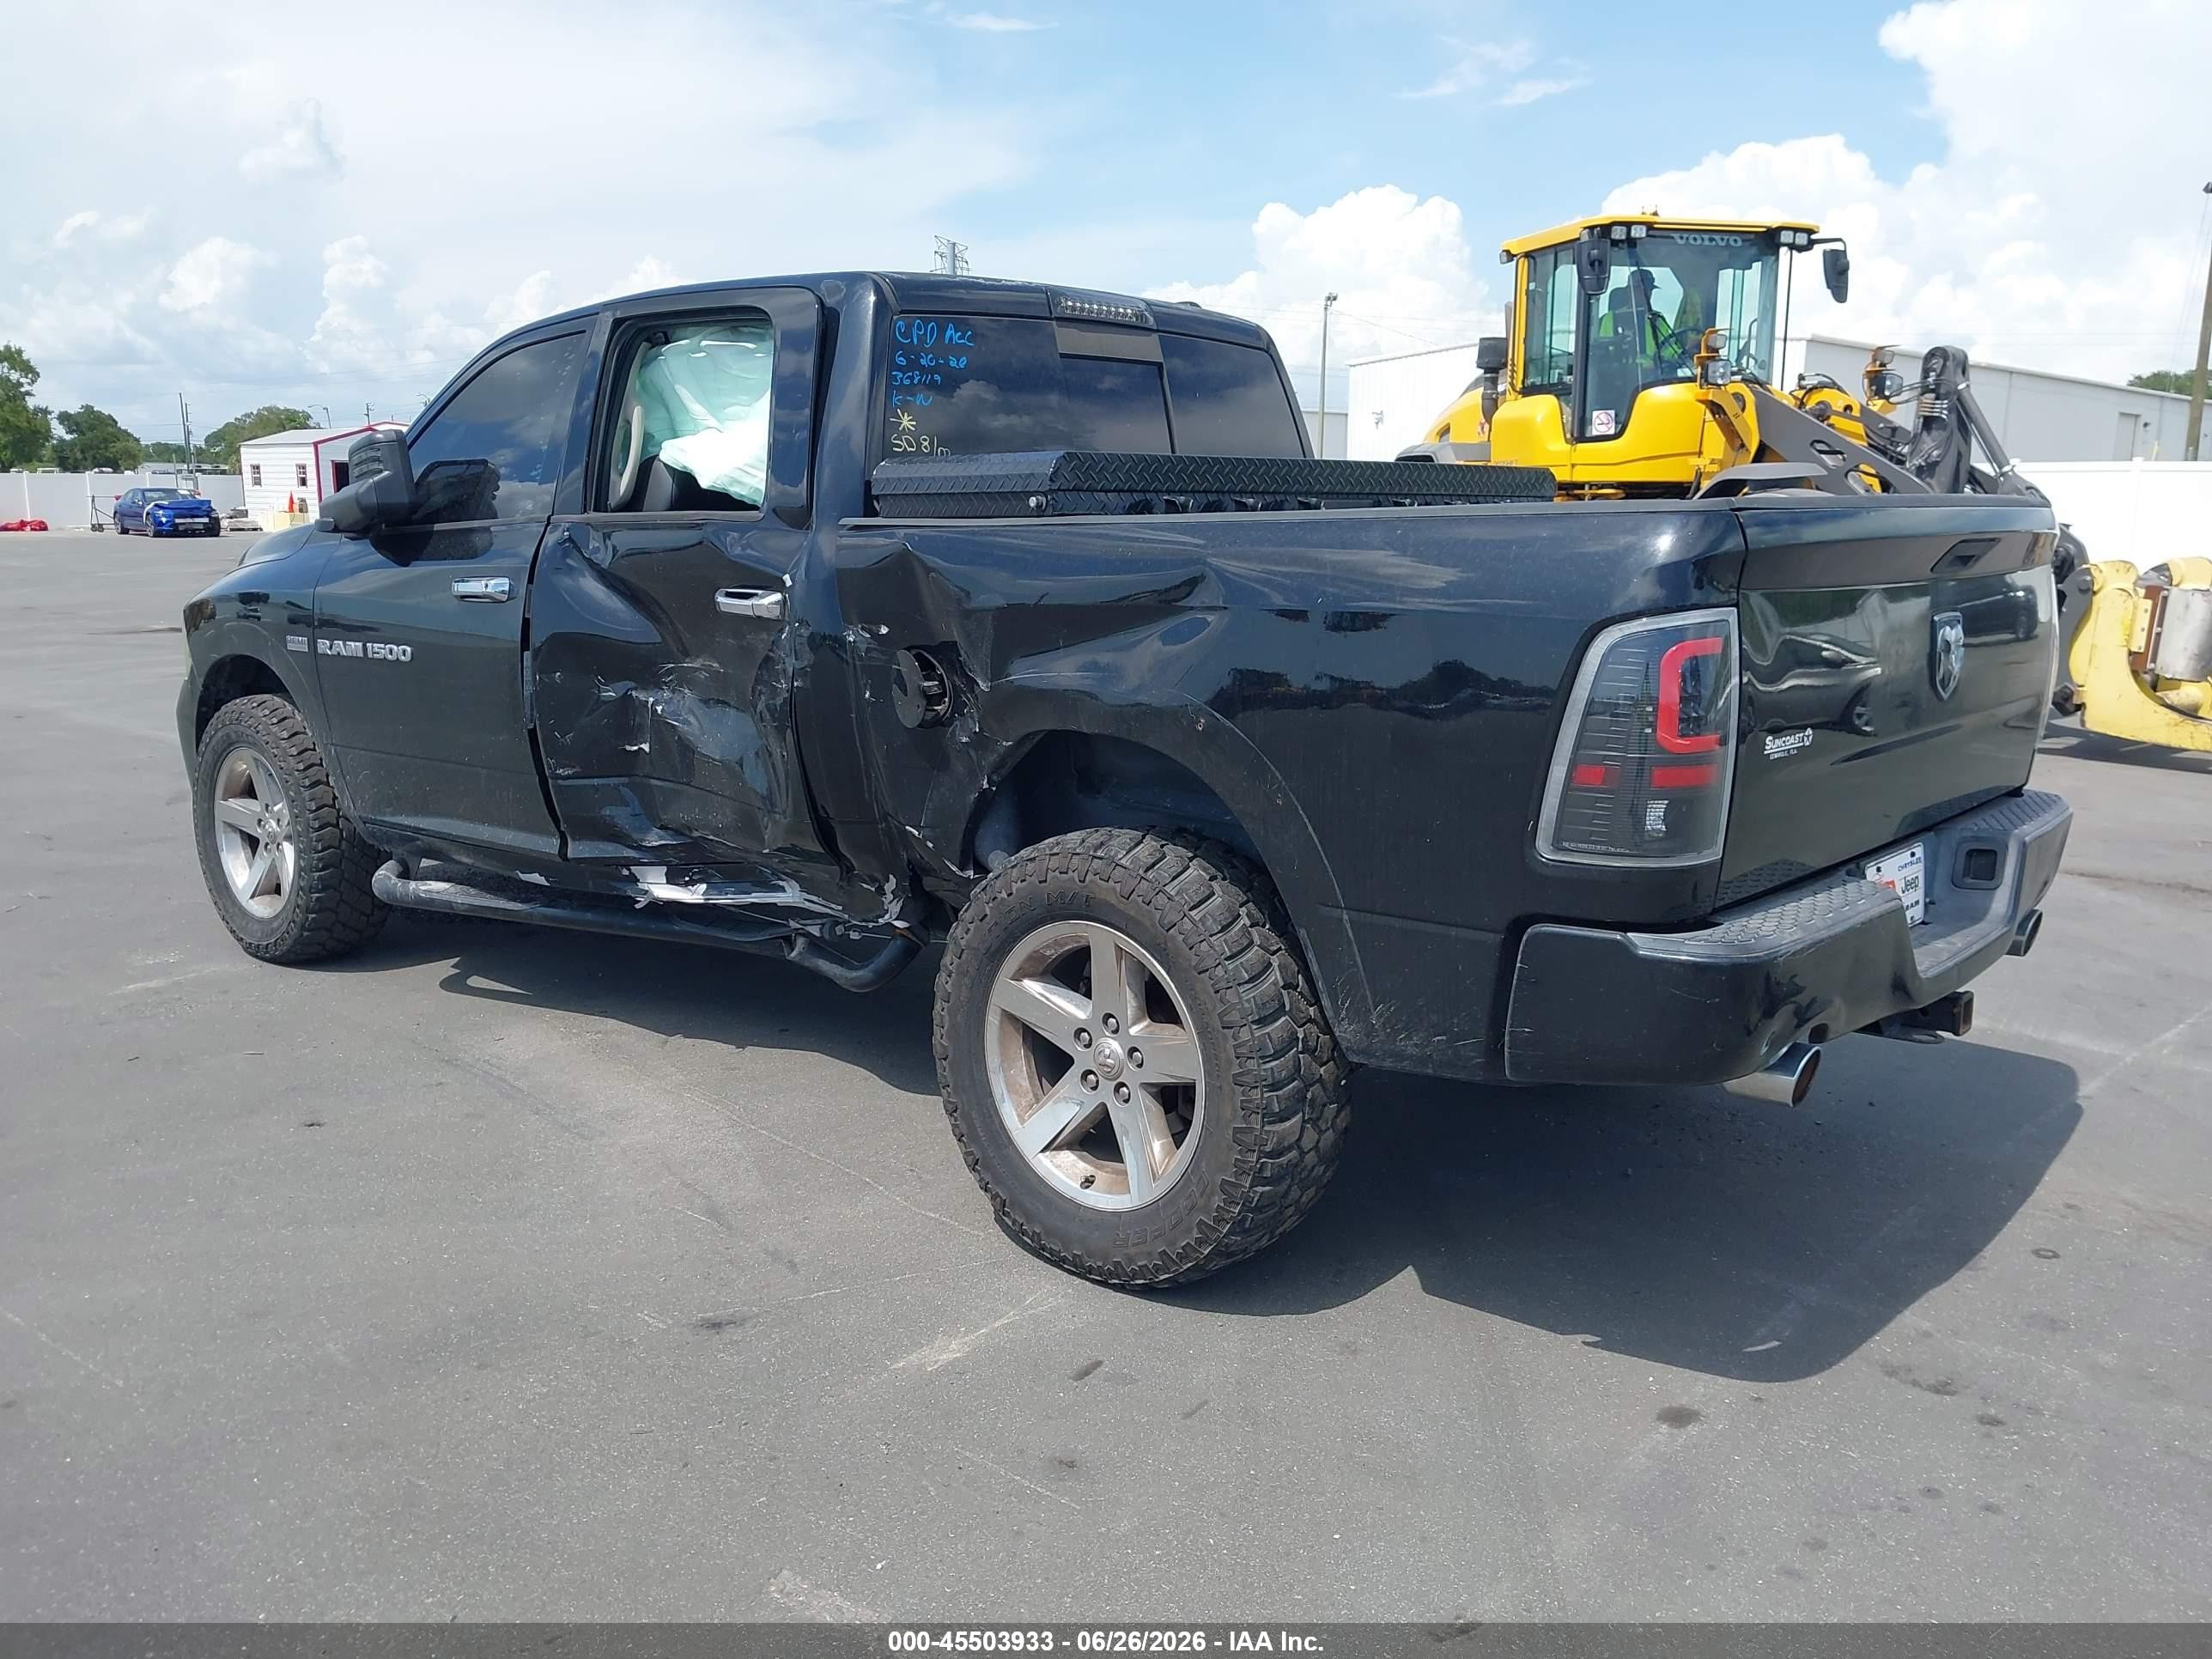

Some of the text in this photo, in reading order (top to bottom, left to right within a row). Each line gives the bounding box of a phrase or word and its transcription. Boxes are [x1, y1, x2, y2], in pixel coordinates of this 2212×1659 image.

[1670, 234, 1742, 247] VOLVO
[896, 319, 937, 348] CPD
[891, 371, 941, 386] 368119
[317, 639, 364, 657] RAM
[367, 643, 412, 662] 1500
[1901, 875, 1919, 895] Jeep
[1905, 900, 1920, 911] RAM
